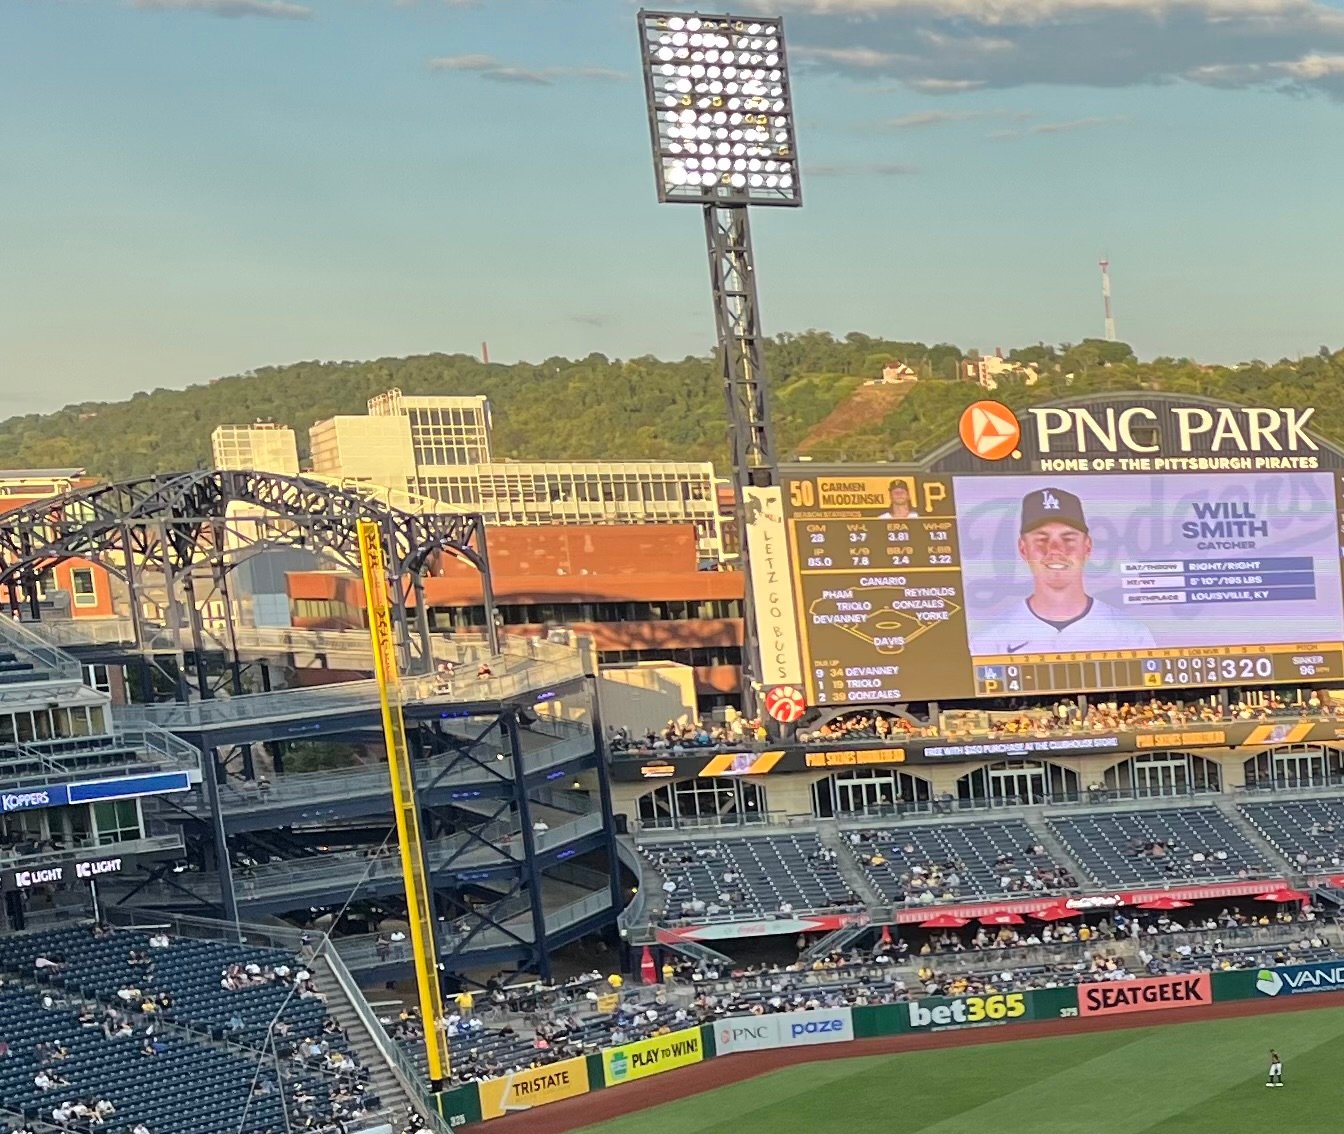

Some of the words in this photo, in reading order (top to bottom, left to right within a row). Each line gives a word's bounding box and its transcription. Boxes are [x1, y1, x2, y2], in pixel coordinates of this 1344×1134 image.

[1028, 406, 1159, 453] PNC
[1170, 406, 1319, 452] PARK
[1040, 458, 1089, 472] HOME
[1093, 458, 1114, 471] OF
[1118, 457, 1151, 471] THE
[1154, 457, 1252, 470] PITTSBURGH
[1255, 456, 1320, 470] PIRATES
[821, 482, 866, 492] CARMEN
[790, 480, 814, 507] 50
[822, 493, 885, 505] MLODZINSKI
[923, 482, 947, 512] P
[1191, 501, 1256, 519] WILL
[887, 523, 909, 531] ERA
[1181, 520, 1268, 539] SMITH
[810, 533, 825, 543] 28
[888, 531, 909, 541] 3.81
[1196, 541, 1256, 550] CATCHER
[763, 531, 778, 584] LETZ
[1189, 562, 1261, 570] RIGHT/RIGHT
[860, 577, 907, 587] CANARIO
[822, 590, 854, 599] PHAM
[904, 587, 955, 597] REYNOLDS
[1254, 591, 1268, 599] KY
[769, 592, 782, 618] GO
[836, 602, 872, 611] TRIOLO
[892, 600, 945, 609] GONZALES
[813, 614, 867, 624] DEVANNEY
[916, 611, 949, 621] YORKE
[874, 637, 905, 646] DAVIS
[773, 626, 787, 679] BUCS
[1292, 656, 1323, 665] SINKER
[829, 668, 844, 677] 34
[845, 666, 899, 677] DEVANNEY
[846, 678, 882, 688] TRIOLO
[848, 690, 902, 700] GONZALES
[2, 791, 49, 811] KOPPERS
[76, 862, 91, 878] IC
[91, 859, 121, 875] LIGHT
[16, 871, 31, 887] IC
[31, 868, 63, 884] LIGHT
[1087, 978, 1204, 1011] SEATGEEK
[908, 993, 1026, 1027] bet365
[733, 1025, 768, 1041] PNC
[791, 1017, 844, 1038] paze
[632, 1047, 660, 1069] PLAY
[661, 1049, 671, 1059] TO
[672, 1037, 698, 1058] WIN!
[512, 1070, 569, 1097] TRISTATE
